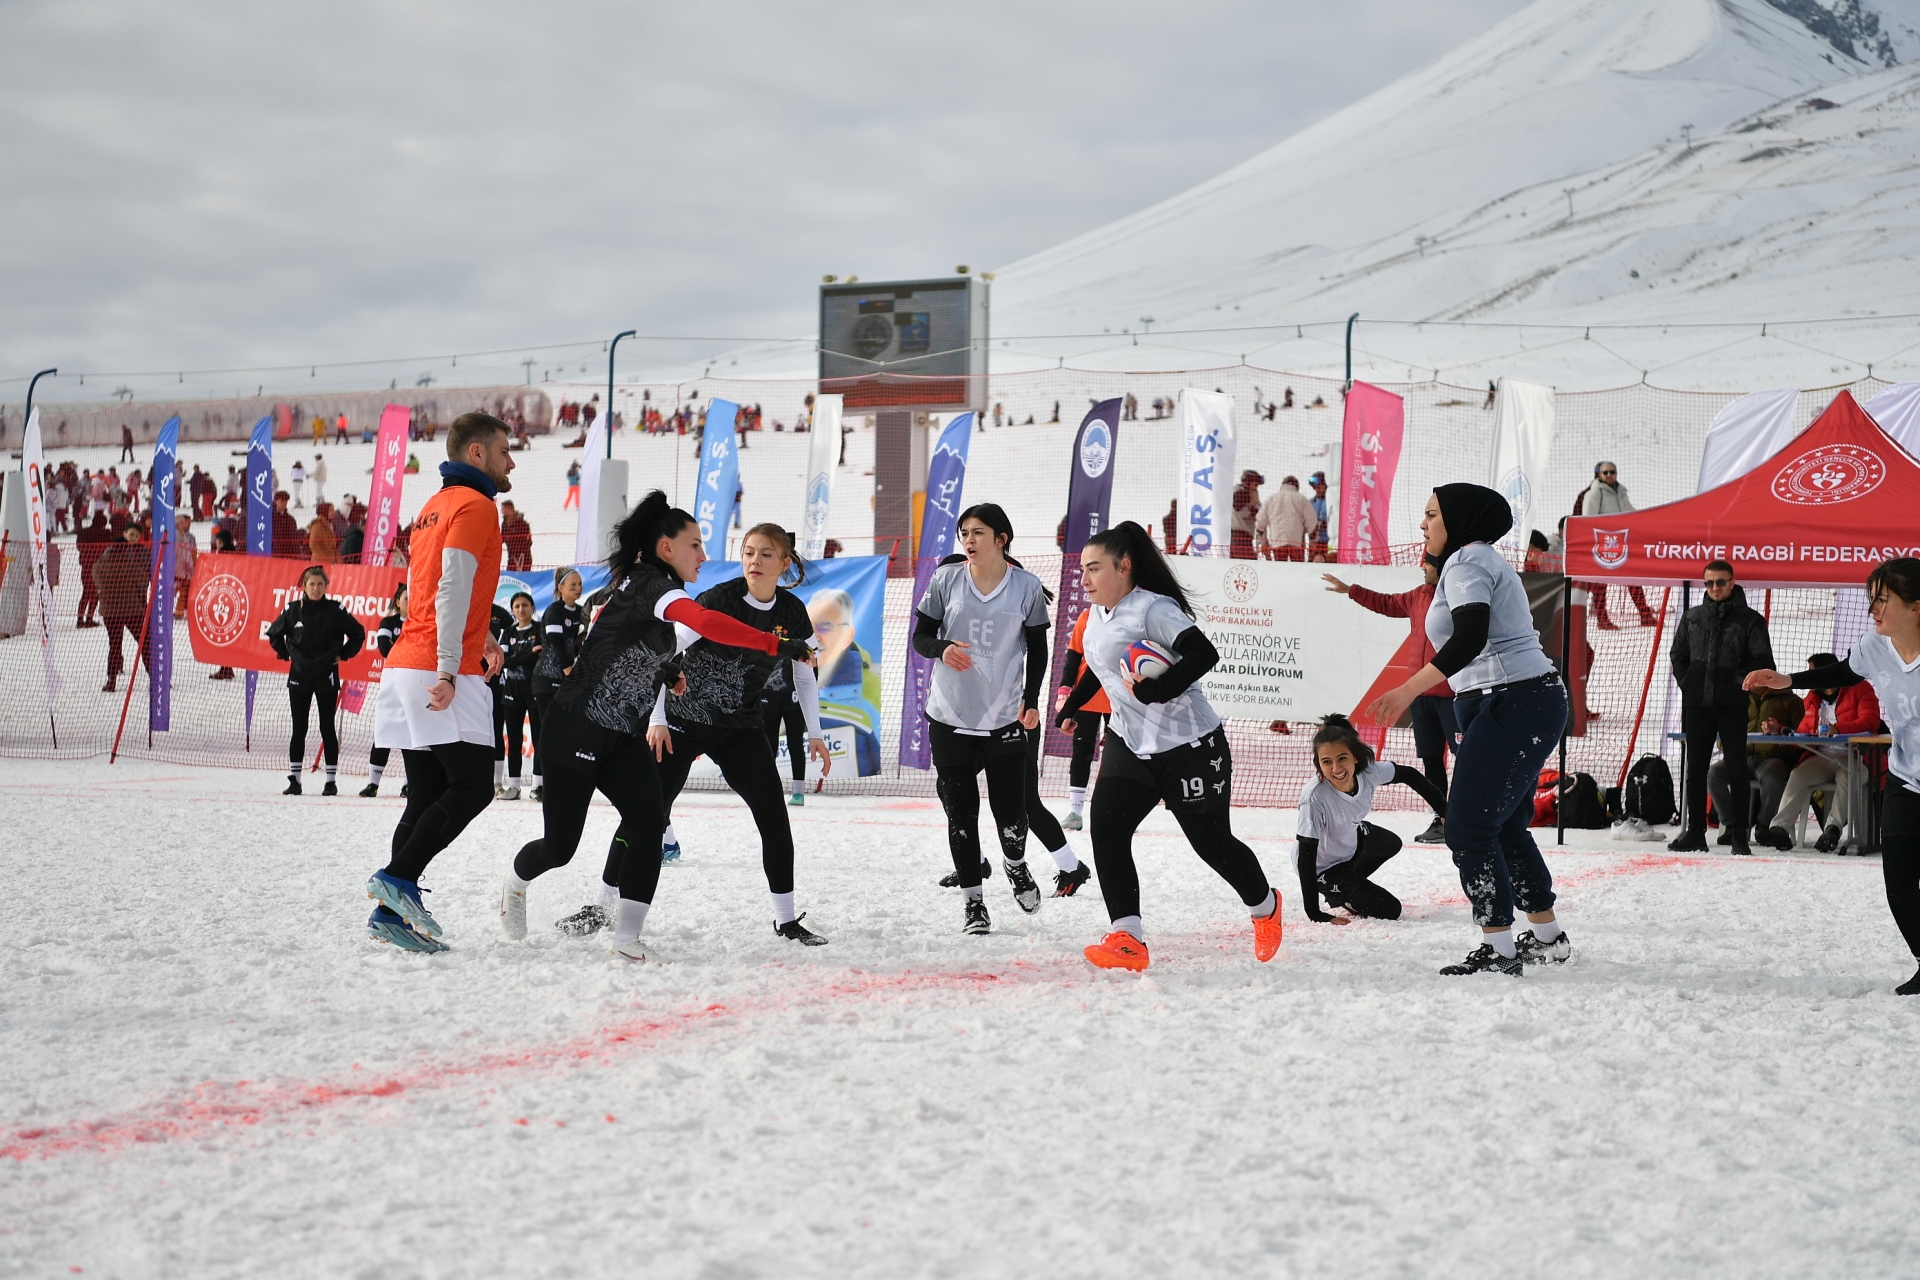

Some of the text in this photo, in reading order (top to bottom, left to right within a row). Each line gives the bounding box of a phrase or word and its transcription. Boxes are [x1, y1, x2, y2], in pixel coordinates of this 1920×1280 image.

[385, 434, 401, 487] A.Ş.
[706, 436, 730, 491] A.Ş.
[1193, 428, 1223, 491] A.Ş.
[1643, 541, 1726, 560] TÜRKİYE
[1732, 541, 1794, 561] RAGBİ
[1205, 604, 1274, 617] T.C. GENÇLİK VE
[1206, 614, 1273, 627] SPOR BAKANLIĞI
[1210, 631, 1301, 650] ANTRENÖR VE
[1238, 663, 1304, 680] DİLİYORUM
[1207, 681, 1236, 690] Osman
[1237, 683, 1261, 693] Aşkın
[1262, 685, 1281, 693] BAK
[1219, 693, 1231, 702] VE
[1232, 694, 1257, 704] SPOR
[1258, 696, 1293, 706] BAKANI
[909, 668, 925, 752] KAYSERİ
[1180, 777, 1204, 797] 19
